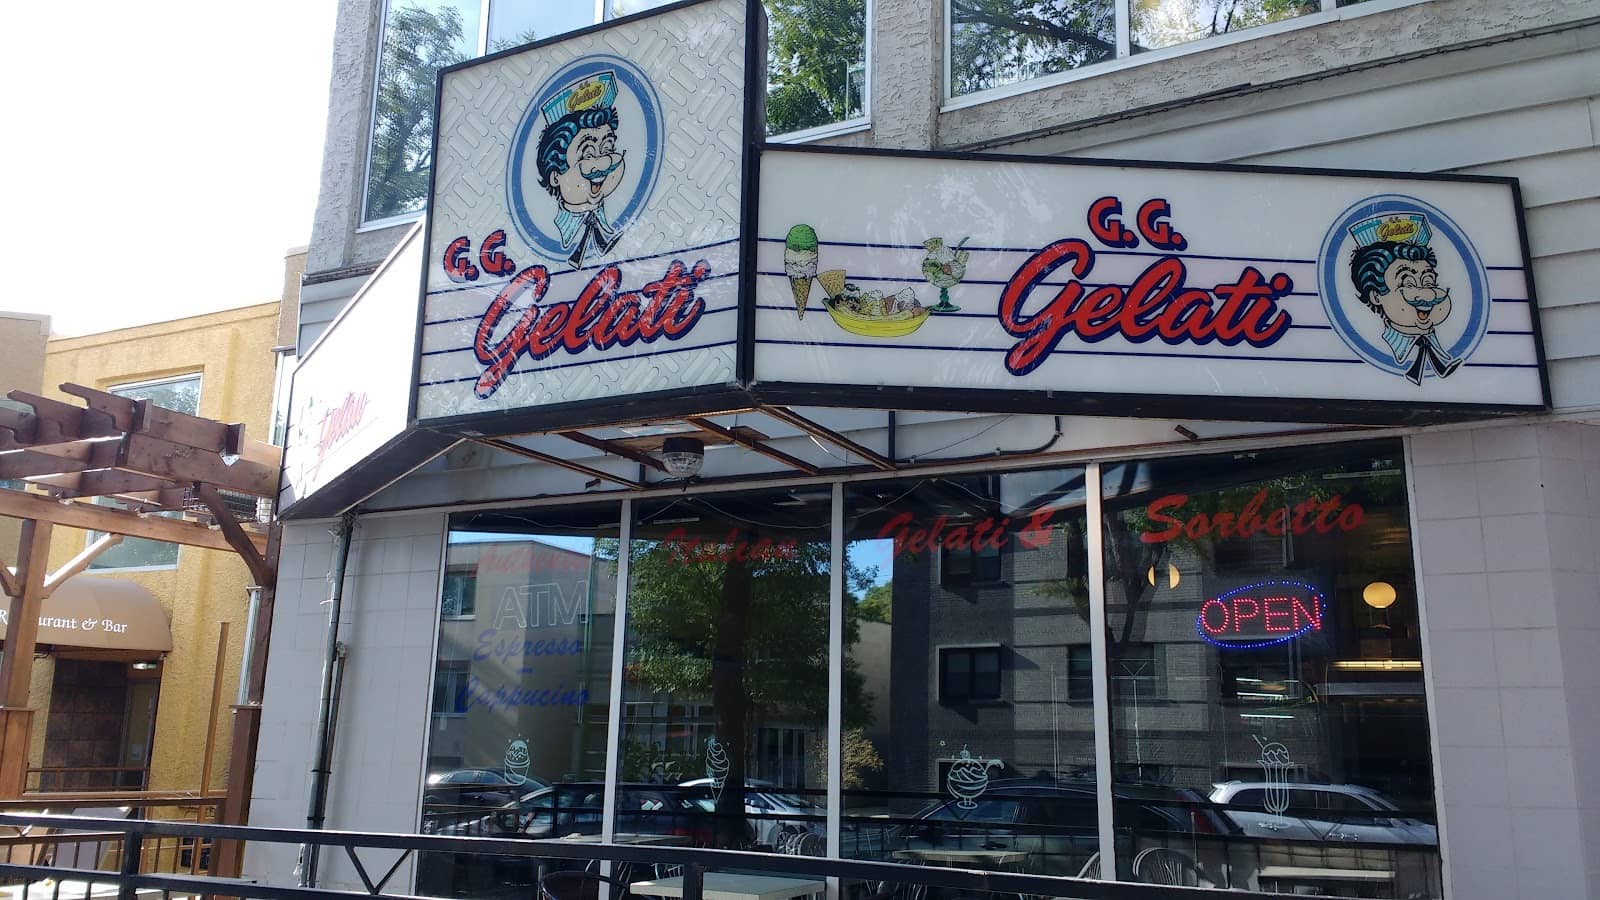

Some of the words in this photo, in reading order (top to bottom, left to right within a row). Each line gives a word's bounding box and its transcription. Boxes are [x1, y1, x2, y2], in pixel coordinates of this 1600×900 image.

[474, 259, 710, 400] Gelati
[998, 238, 1292, 377] Gelati
[877, 511, 1009, 562] Gelati
[1018, 505, 1056, 549] &
[1139, 489, 1364, 543] Sorbetto
[81, 618, 98, 631] &
[101, 619, 128, 633] Bar
[492, 580, 590, 630] ATM
[1201, 597, 1321, 635] OPEN
[473, 628, 581, 664] Espresso
